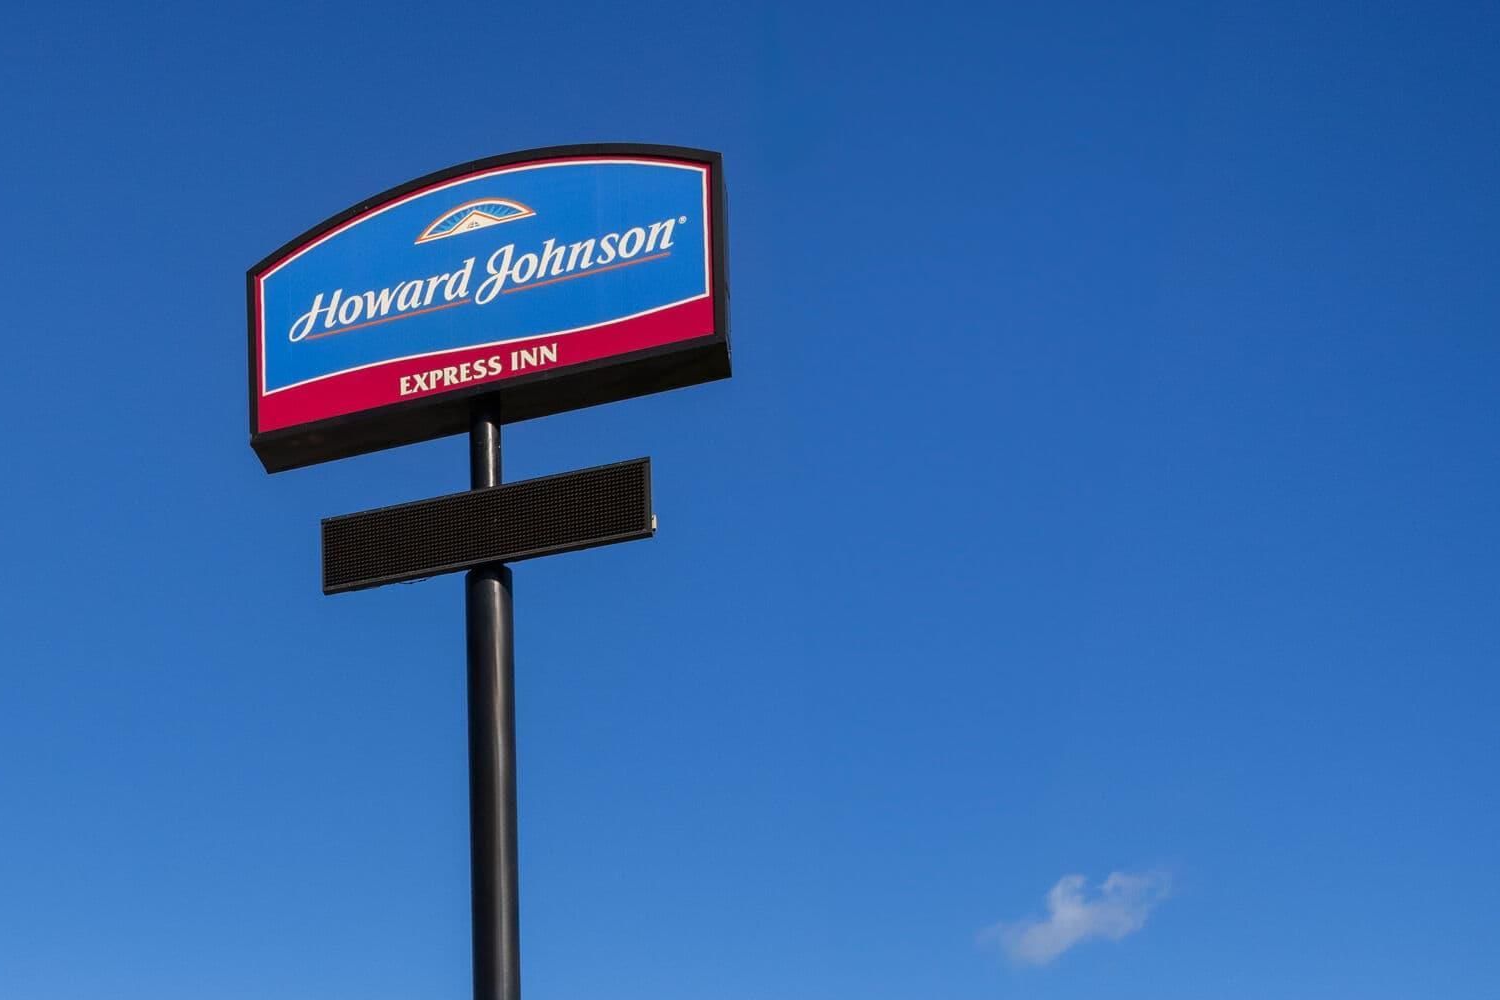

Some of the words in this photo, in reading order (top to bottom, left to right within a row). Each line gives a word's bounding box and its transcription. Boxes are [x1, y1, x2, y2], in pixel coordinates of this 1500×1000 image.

[288, 257, 476, 342] Howard
[474, 218, 676, 305] Johnson
[399, 355, 503, 397] EXPRESS
[511, 343, 558, 371] INN
